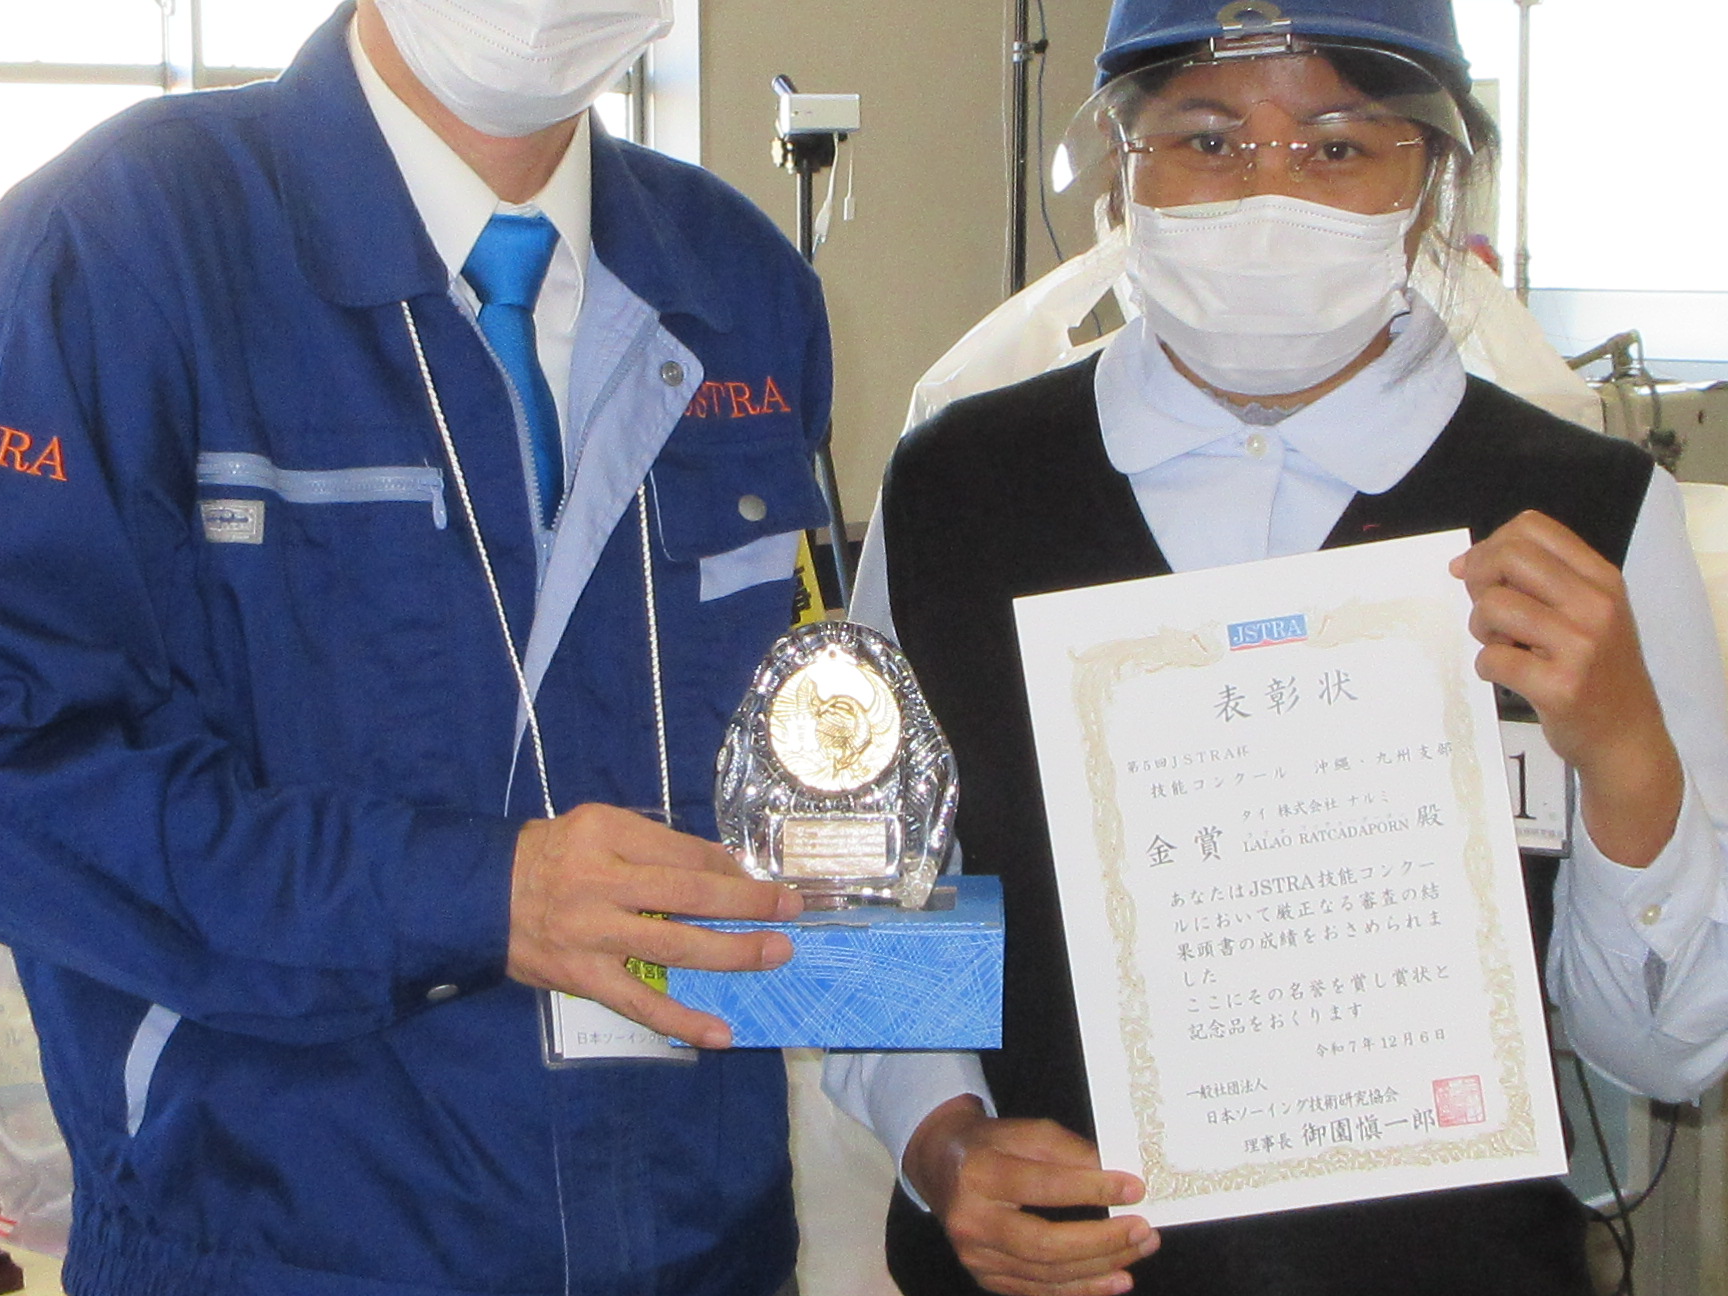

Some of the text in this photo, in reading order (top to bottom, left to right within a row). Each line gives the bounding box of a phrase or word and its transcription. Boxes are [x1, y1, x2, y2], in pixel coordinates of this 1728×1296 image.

[1233, 618, 1306, 645] JSTRA
[1213, 669, 1359, 723] 表彰状
[1150, 765, 1287, 800] 技能コンクール
[1509, 751, 1537, 820] 1
[1278, 797, 1338, 818] 株式会社
[1146, 825, 1223, 868] 金賞
[1243, 835, 1292, 853] LALAO
[1416, 803, 1446, 828] 殿
[1171, 859, 1436, 908] あなたはJSTRA技能コンクー
[1174, 882, 1440, 933] ルにおいて厳正なる審査の結
[1177, 909, 1442, 962] 果頭書の成績をおさめられま
[1184, 968, 1217, 988] した
[1186, 964, 1450, 1014] ここにその名誉を賞し賞状と
[1189, 1002, 1363, 1041] 記念品をおくります
[1316, 1029, 1446, 1057] 令和7年12月6日
[1186, 1078, 1268, 1100] 一般社団法人
[1207, 1086, 1400, 1125] 日本ソーイング技術研究協会
[1244, 1132, 1292, 1154] 理事長
